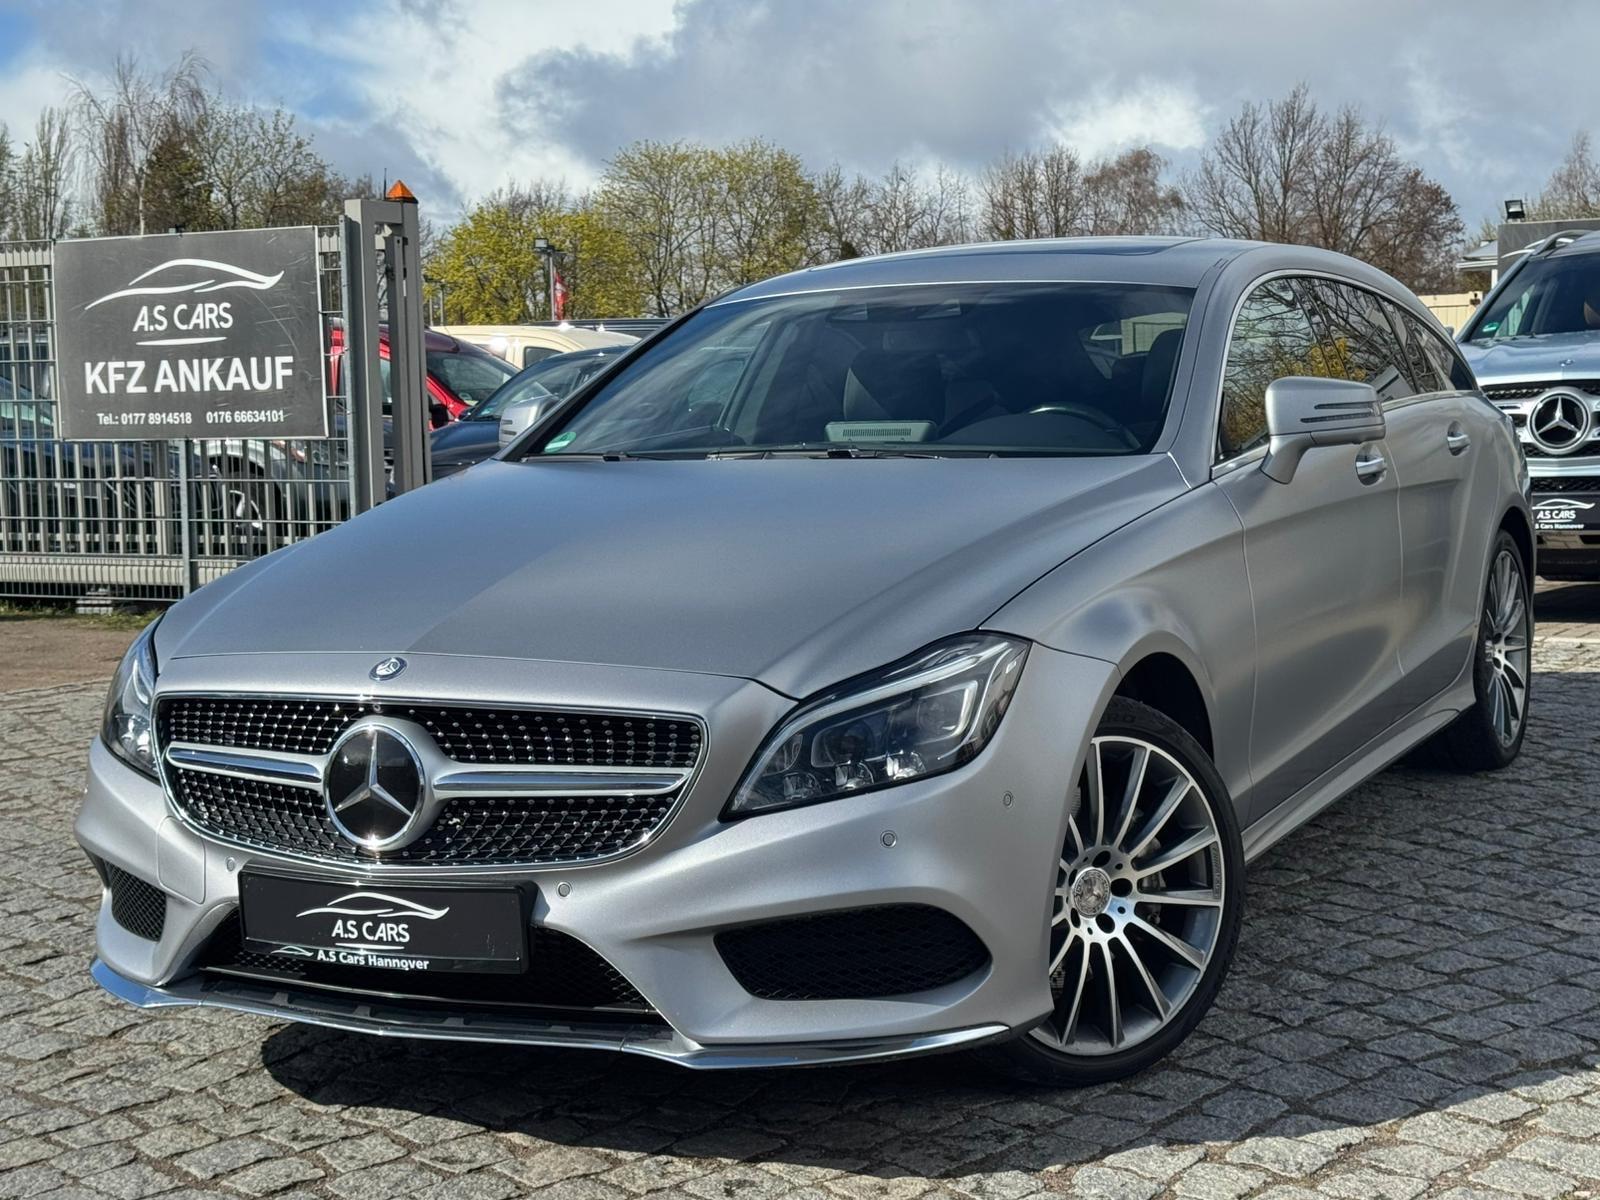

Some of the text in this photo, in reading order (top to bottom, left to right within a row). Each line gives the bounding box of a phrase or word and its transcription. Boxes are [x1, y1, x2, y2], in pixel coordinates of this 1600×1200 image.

[132, 302, 234, 332] A.S CARS
[84, 355, 294, 394] KFZ ANKAUF
[96, 409, 285, 425] Tel.: 0177 8914518 0176 66634101
[1552, 510, 1576, 519] CARS
[331, 919, 410, 943] A.S CARS
[317, 949, 429, 970] A.S Cars Hannover
